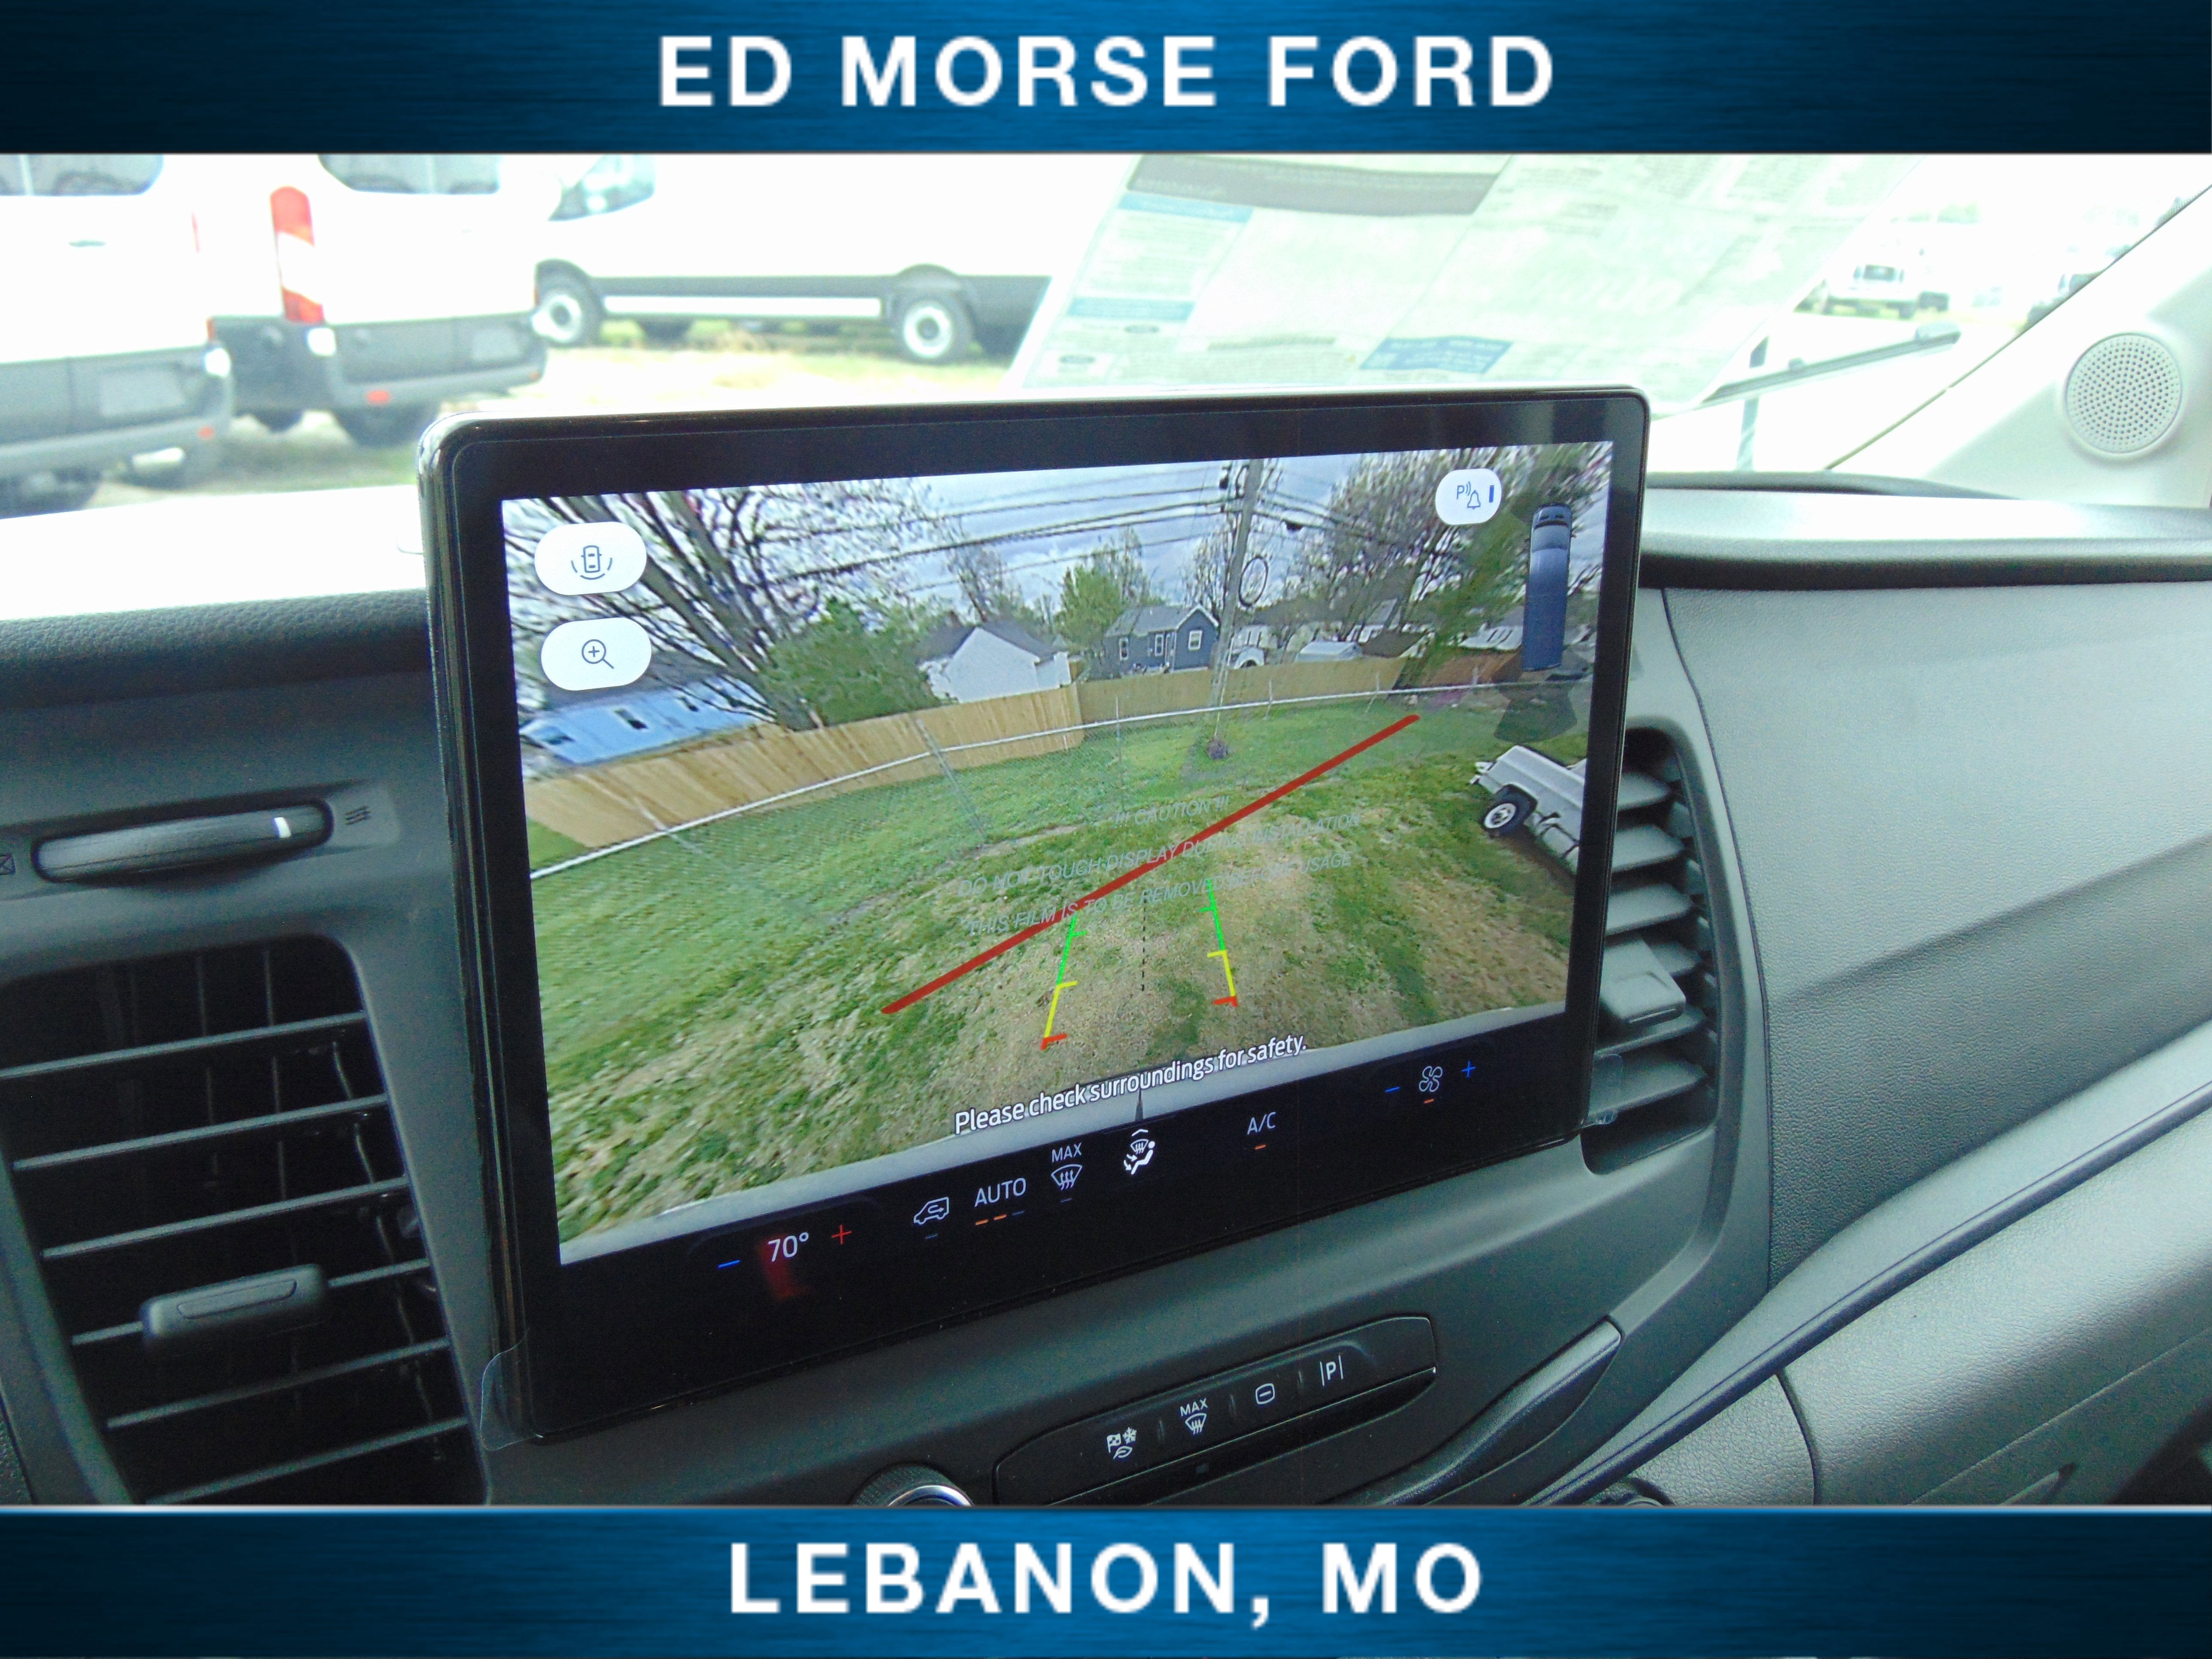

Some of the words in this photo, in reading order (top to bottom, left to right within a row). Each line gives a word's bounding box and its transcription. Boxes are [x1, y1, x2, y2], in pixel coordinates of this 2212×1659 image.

[1134, 799, 1212, 825] CAUTION
[957, 877, 988, 896] DO
[993, 870, 1031, 890] NOT
[1039, 859, 1101, 881] TOUCH
[1106, 845, 1177, 871] DISPLAY
[1252, 812, 1361, 844] INSTALLATION
[968, 915, 1009, 937] THIS
[1014, 906, 1056, 929] FILM
[1061, 902, 1079, 919] IS
[1084, 897, 1107, 915] TO
[1111, 890, 1136, 911] BE
[1140, 876, 1224, 904] REMOVED
[1300, 852, 1352, 874] USAGE
[954, 1101, 1025, 1134] Please
[1029, 1083, 1086, 1116] check
[1090, 1055, 1214, 1102] surroundings
[1217, 1049, 1244, 1071] for
[1246, 1033, 1307, 1065] safety.
[1247, 1111, 1276, 1135] A/C
[1051, 1142, 1083, 1163] MAX
[974, 1177, 1027, 1207] AUTO
[767, 1231, 809, 1262] 70°
[1179, 1398, 1209, 1417] MAX
